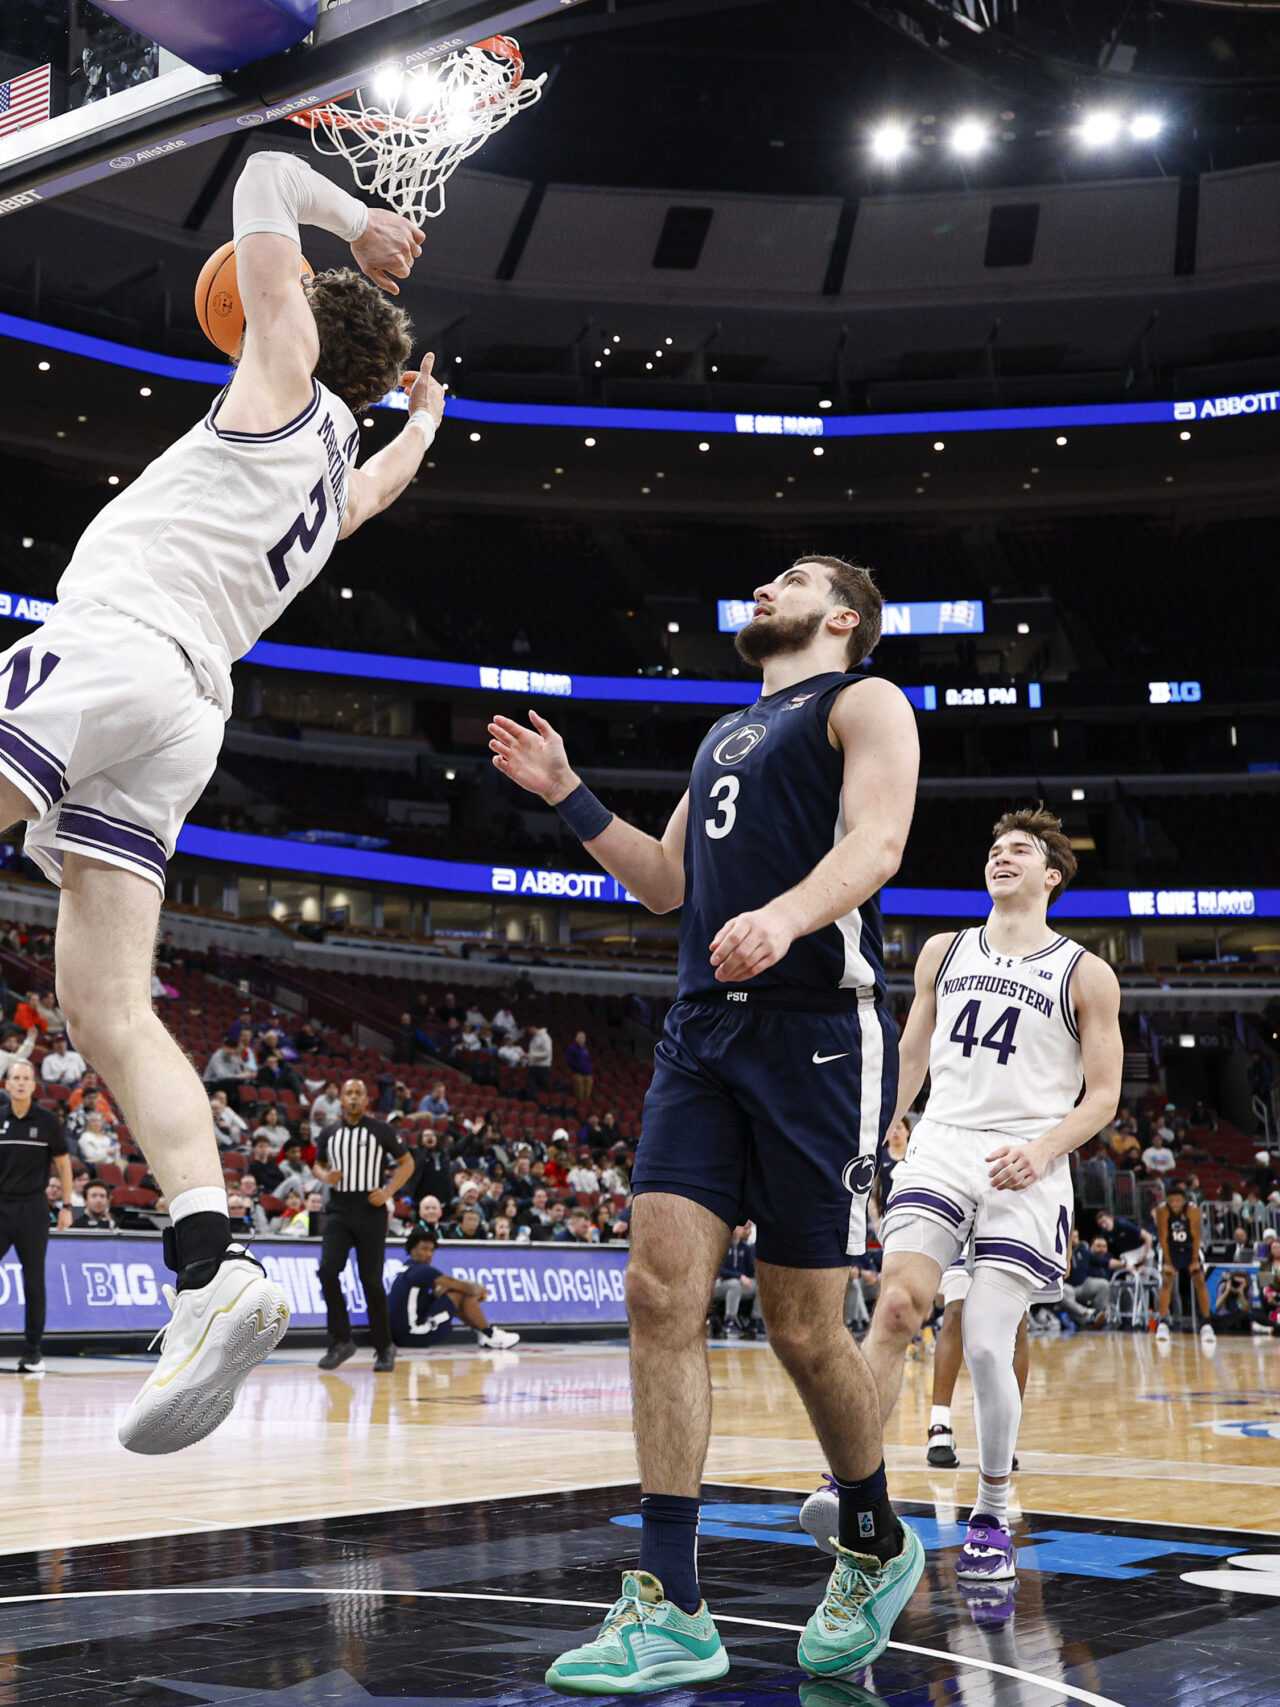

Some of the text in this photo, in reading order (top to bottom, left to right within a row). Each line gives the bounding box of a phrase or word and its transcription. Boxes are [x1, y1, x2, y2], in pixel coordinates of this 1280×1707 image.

[405, 37, 464, 65] Allstate
[265, 93, 321, 120] Allstate
[135, 137, 189, 163] Allstate
[1200, 391, 1280, 419] ABBOTT
[266, 474, 328, 593] 2
[988, 687, 1017, 704] PM
[705, 774, 740, 840] 3
[520, 869, 606, 898] ABBOTT
[726, 990, 749, 1003] PSU
[941, 974, 1055, 1019] NORTHWESTERN
[949, 998, 1022, 1066] 44
